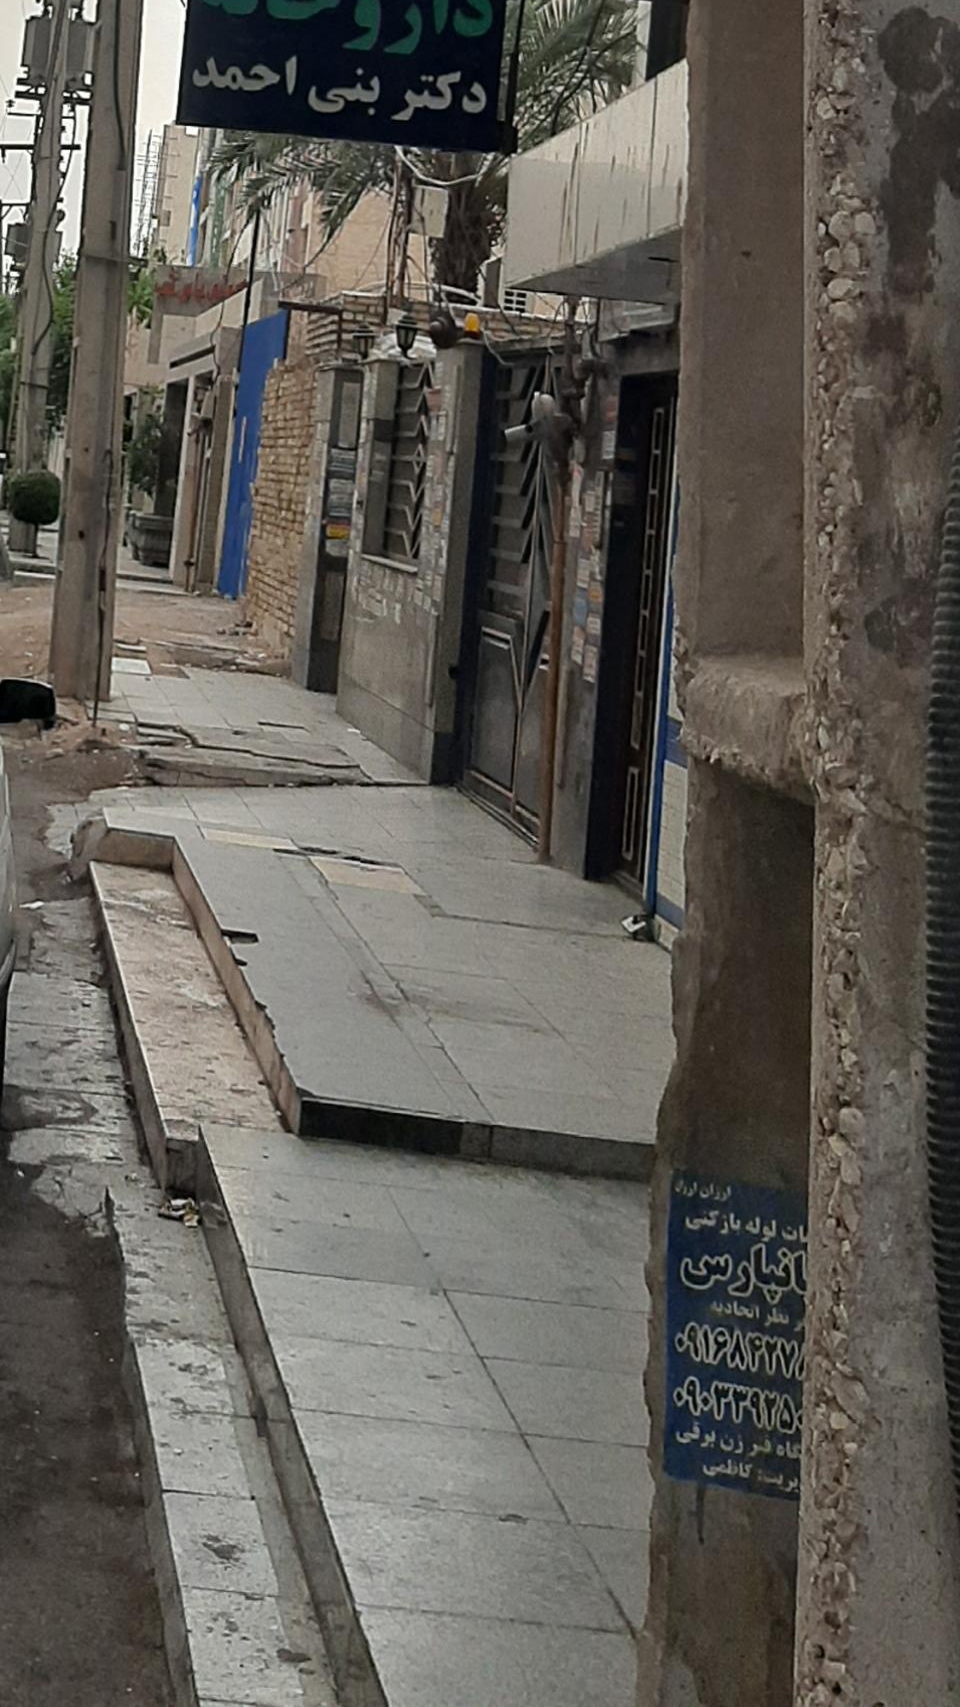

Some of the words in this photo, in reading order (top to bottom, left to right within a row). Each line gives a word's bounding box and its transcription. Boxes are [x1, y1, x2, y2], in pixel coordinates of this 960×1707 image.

[192, 55, 299, 95] احمد
[307, 66, 382, 121] بنی
[391, 71, 488, 122] دکتر
[745, 1215, 777, 1243] لوله
[679, 1242, 808, 1304] انپارس
[709, 1299, 760, 1320] اتحادیه
[764, 1307, 790, 1328] نظر
[675, 1421, 716, 1448] برقی
[702, 1458, 753, 1479] کاظمی
